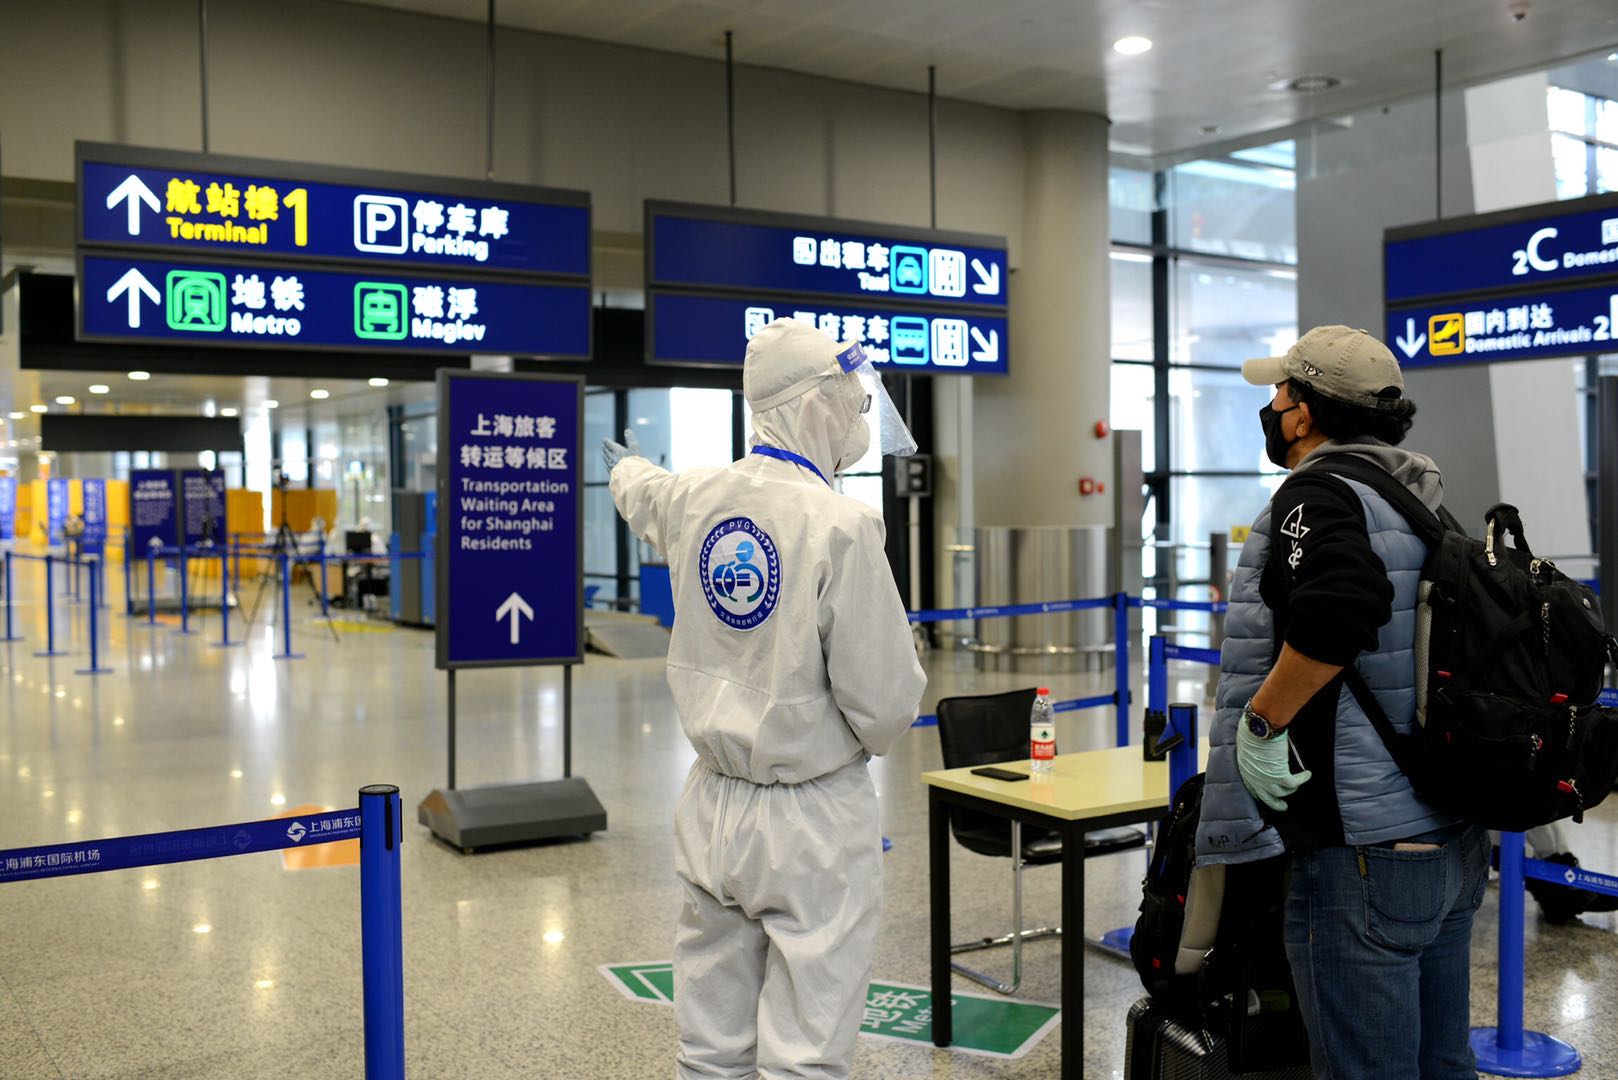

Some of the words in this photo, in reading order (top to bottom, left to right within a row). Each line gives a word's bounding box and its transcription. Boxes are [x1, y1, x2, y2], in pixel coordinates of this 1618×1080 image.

[166, 178, 278, 220] 航站楼
[283, 189, 308, 246] 1
[366, 204, 396, 243] P
[412, 200, 509, 239] 停车库
[166, 217, 268, 244] Terminal
[412, 233, 488, 261] Parking
[820, 239, 889, 271] 出租车
[1512, 227, 1559, 275] 2C
[231, 274, 305, 311] 地铁
[858, 272, 889, 291] Taxi
[412, 286, 478, 320] 磁浮
[231, 312, 301, 336] Metro
[412, 318, 486, 343] Maglev
[1465, 303, 1554, 336] 国内到达
[1465, 333, 1532, 353] Domestic
[1533, 326, 1592, 347] Arrivals
[470, 413, 557, 439] 上海旅客
[460, 445, 568, 470] 转运等候区
[461, 478, 569, 496] Transportation
[461, 497, 518, 515] Waiting
[521, 498, 555, 513] Area
[461, 516, 482, 531] for
[486, 516, 554, 535] Shanghai
[728, 520, 751, 530] PVG
[461, 536, 532, 550] Residents
